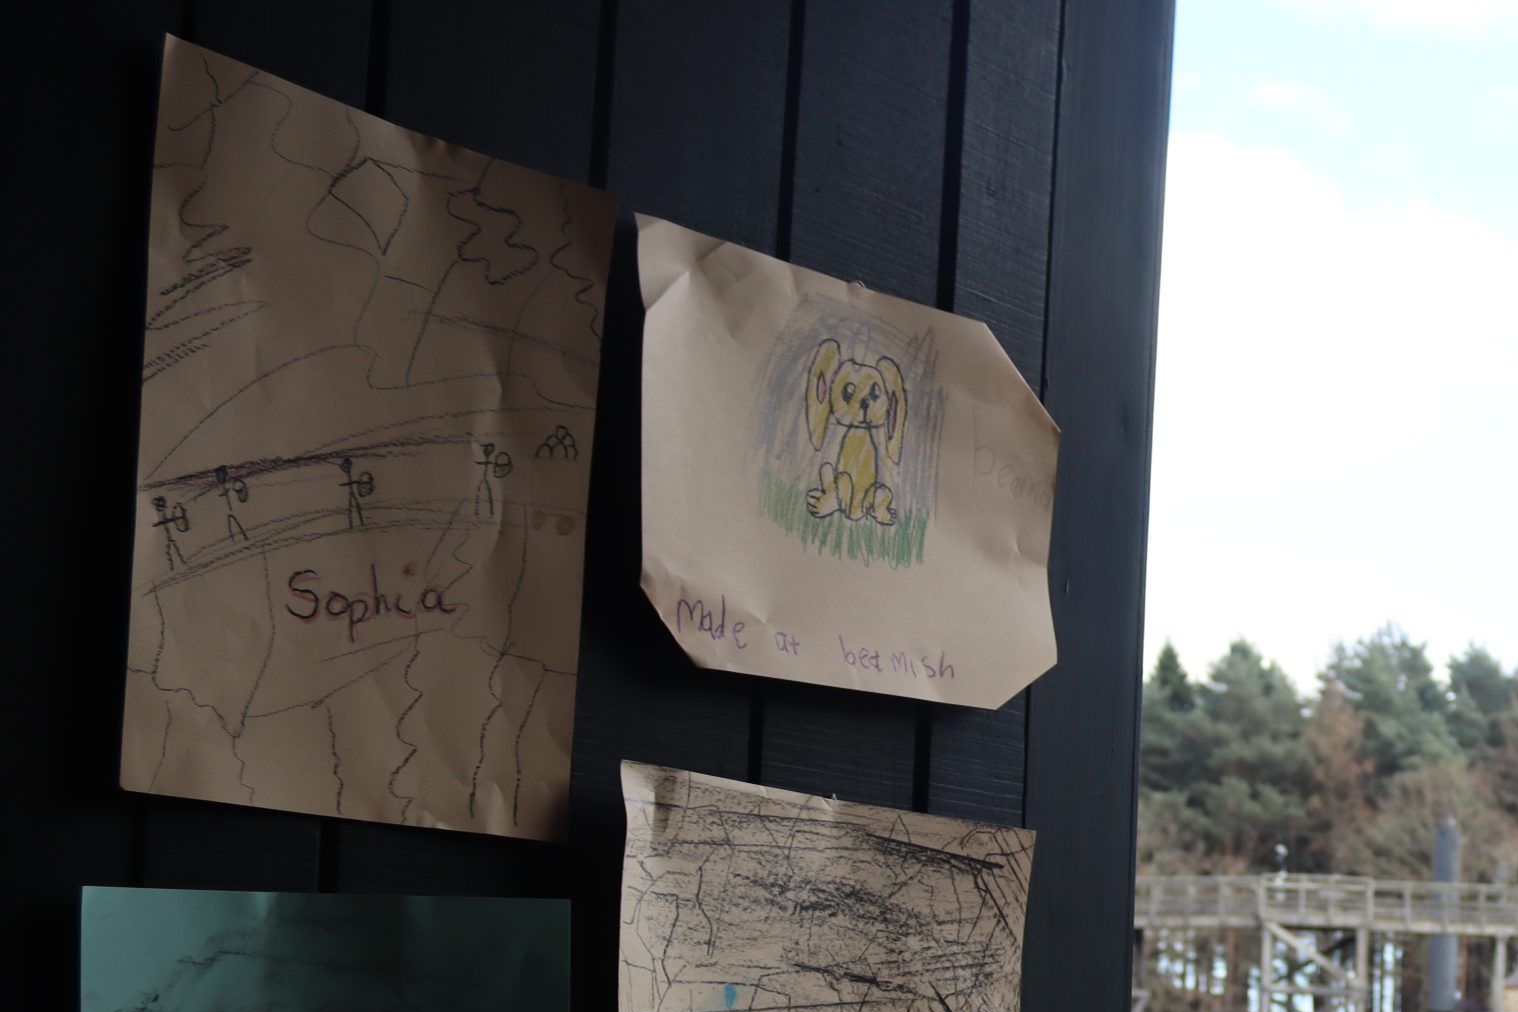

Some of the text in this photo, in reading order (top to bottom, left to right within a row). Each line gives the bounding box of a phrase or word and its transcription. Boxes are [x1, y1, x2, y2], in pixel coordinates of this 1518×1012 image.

[286, 563, 457, 643] Sophia
[676, 594, 748, 650] Made
[774, 631, 800, 656] at
